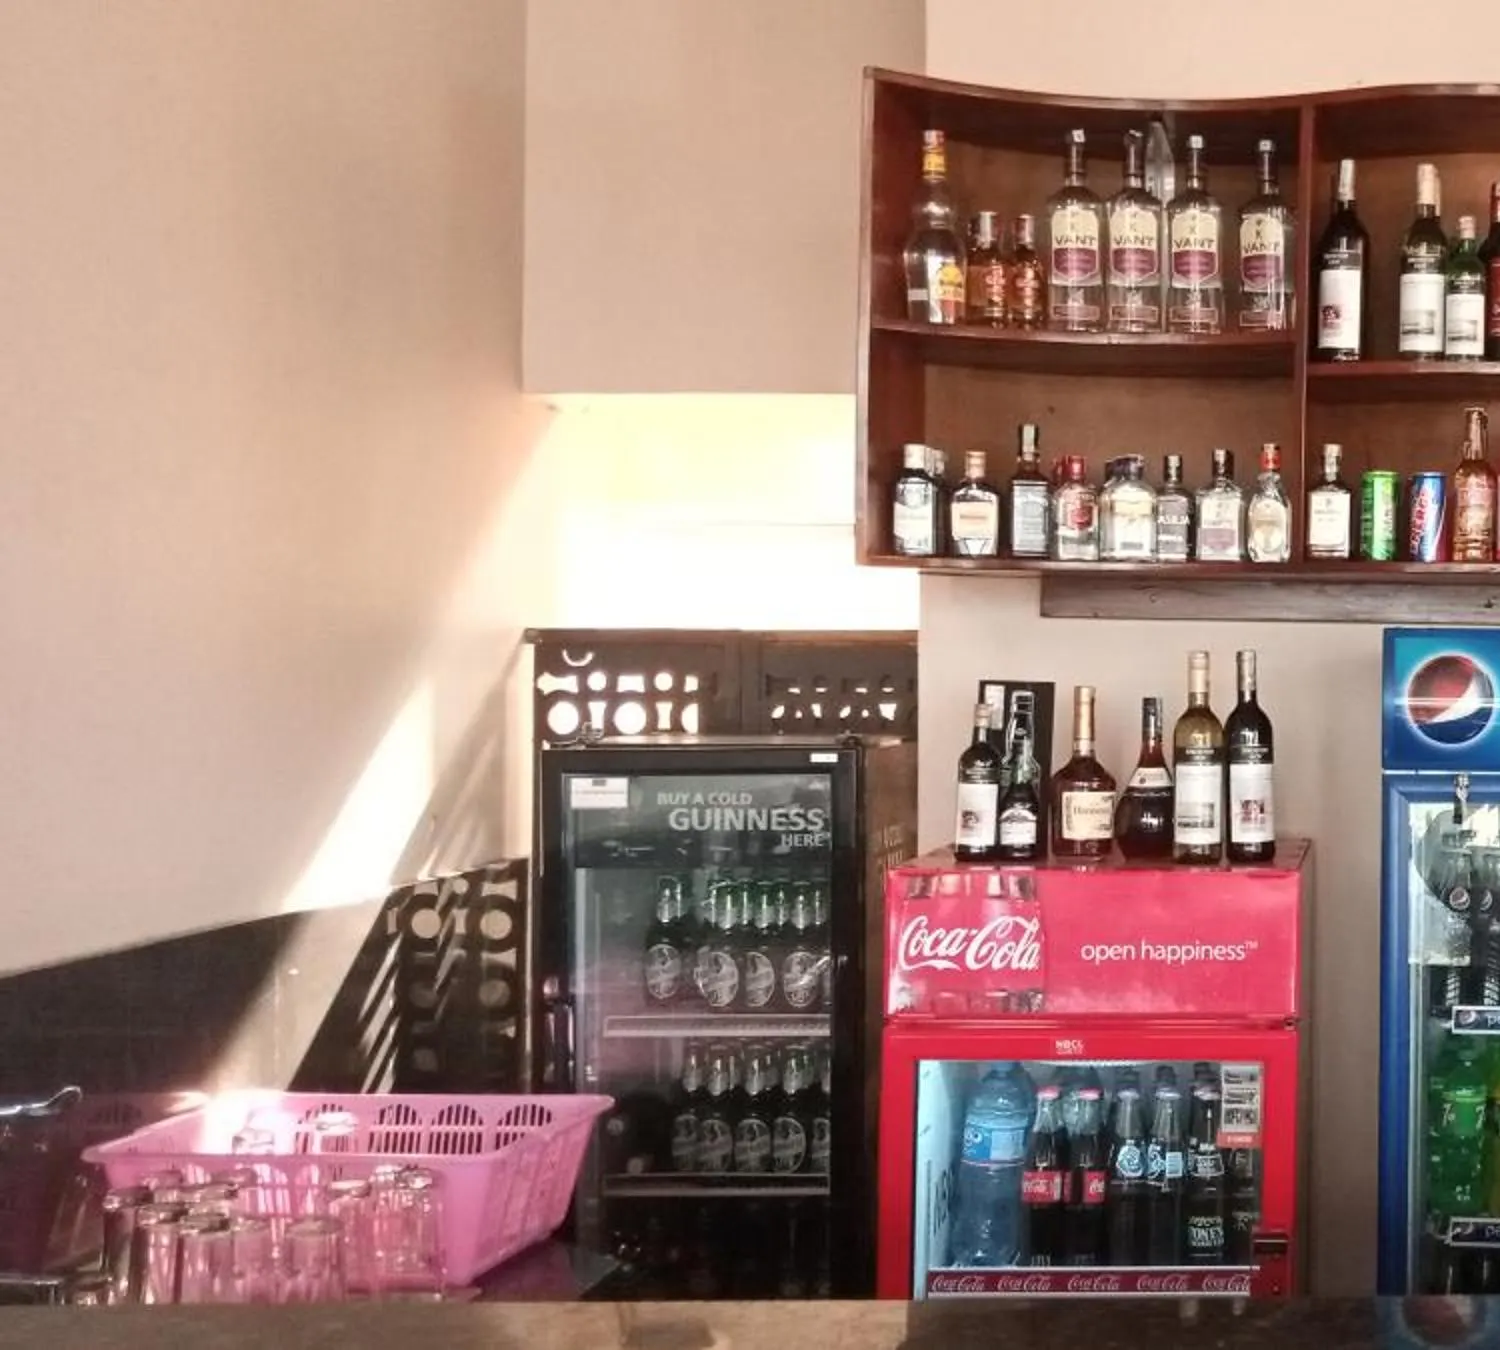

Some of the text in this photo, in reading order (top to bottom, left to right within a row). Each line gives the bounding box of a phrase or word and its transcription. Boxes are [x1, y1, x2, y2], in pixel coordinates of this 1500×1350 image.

[1055, 235, 1096, 246] VANT
[1113, 235, 1154, 246] VANT
[657, 792, 753, 805] BUY A COLD
[668, 808, 825, 831] GUINNESS
[781, 833, 823, 847] HERE
[900, 915, 1041, 972] Coca-Cola
[1080, 942, 1136, 962] open
